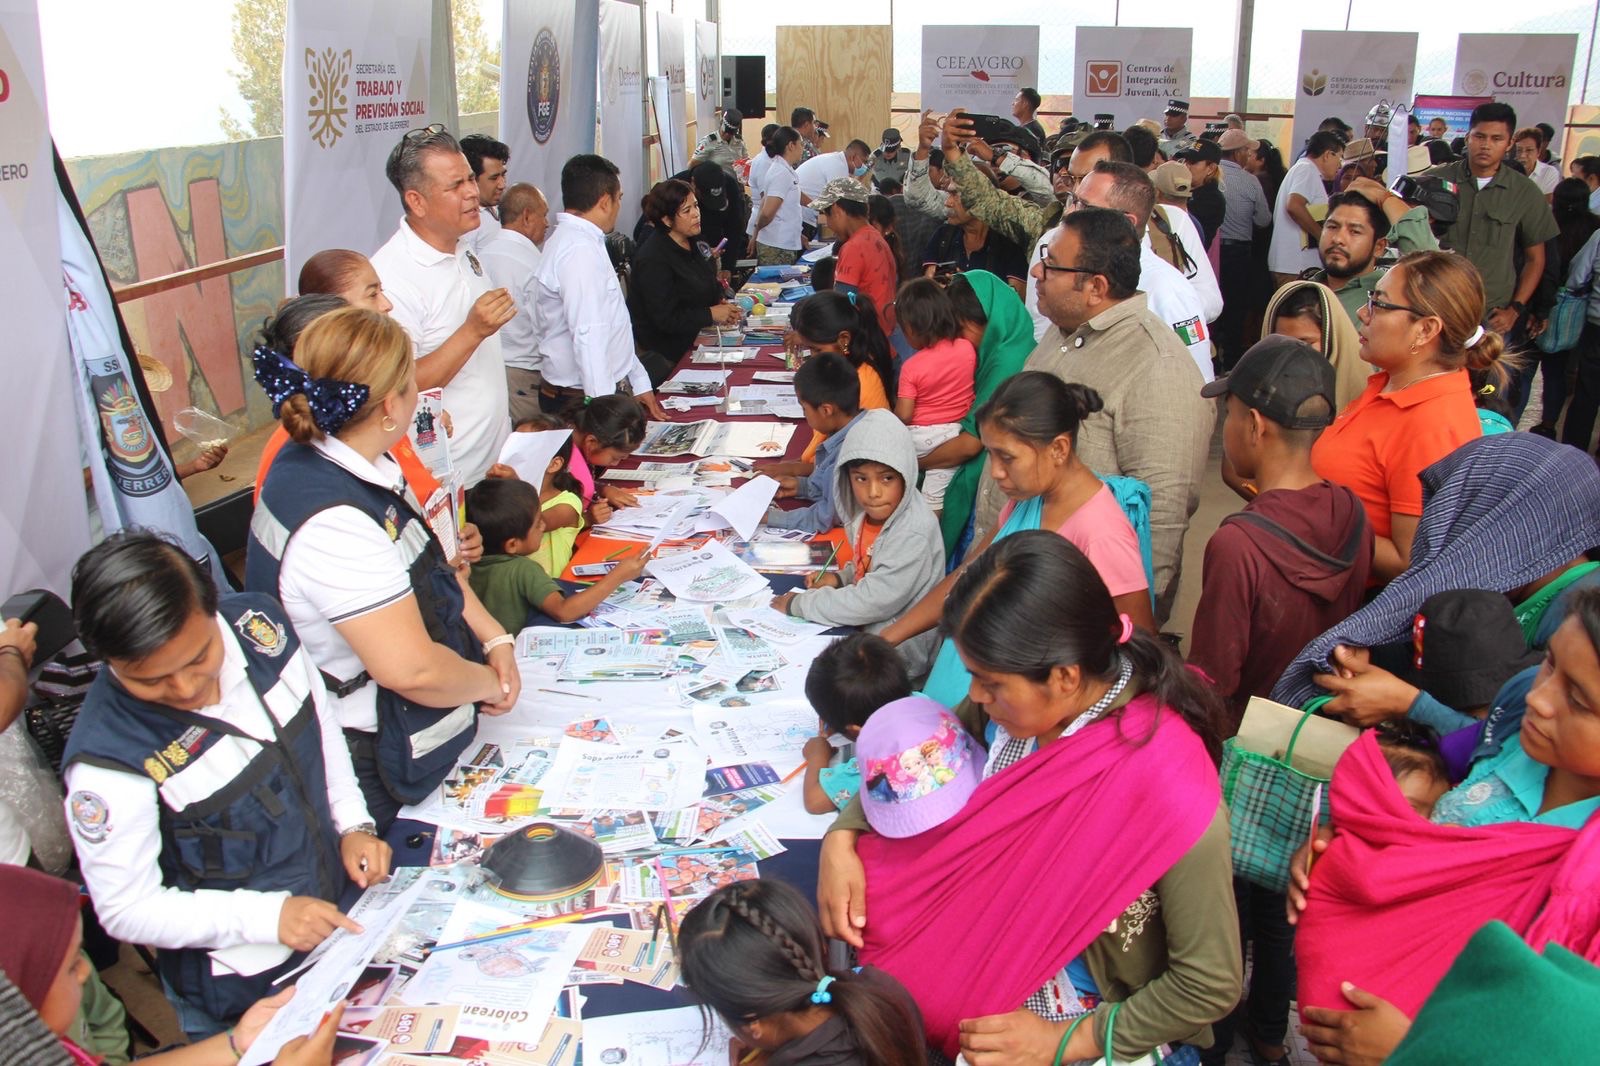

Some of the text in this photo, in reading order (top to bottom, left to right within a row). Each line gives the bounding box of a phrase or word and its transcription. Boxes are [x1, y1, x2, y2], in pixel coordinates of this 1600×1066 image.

[936, 56, 1024, 69] CEEAVGRO
[1126, 63, 1175, 73] Centros de
[387, 65, 396, 74] DEL
[1126, 75, 1177, 86] Integración
[1493, 71, 1565, 88] Cultura
[355, 80, 402, 96] TRABAJO Y
[1125, 88, 1183, 97] Juvenil, A.C.
[355, 98, 425, 120] PREVISIÓN SOCIAL
[538, 101, 550, 117] FGE
[355, 124, 364, 134] DEL
[365, 123, 381, 132] ESTADO
[383, 122, 389, 131] DE
[104, 359, 121, 373] SS
[396, 1013, 415, 1033] 089
